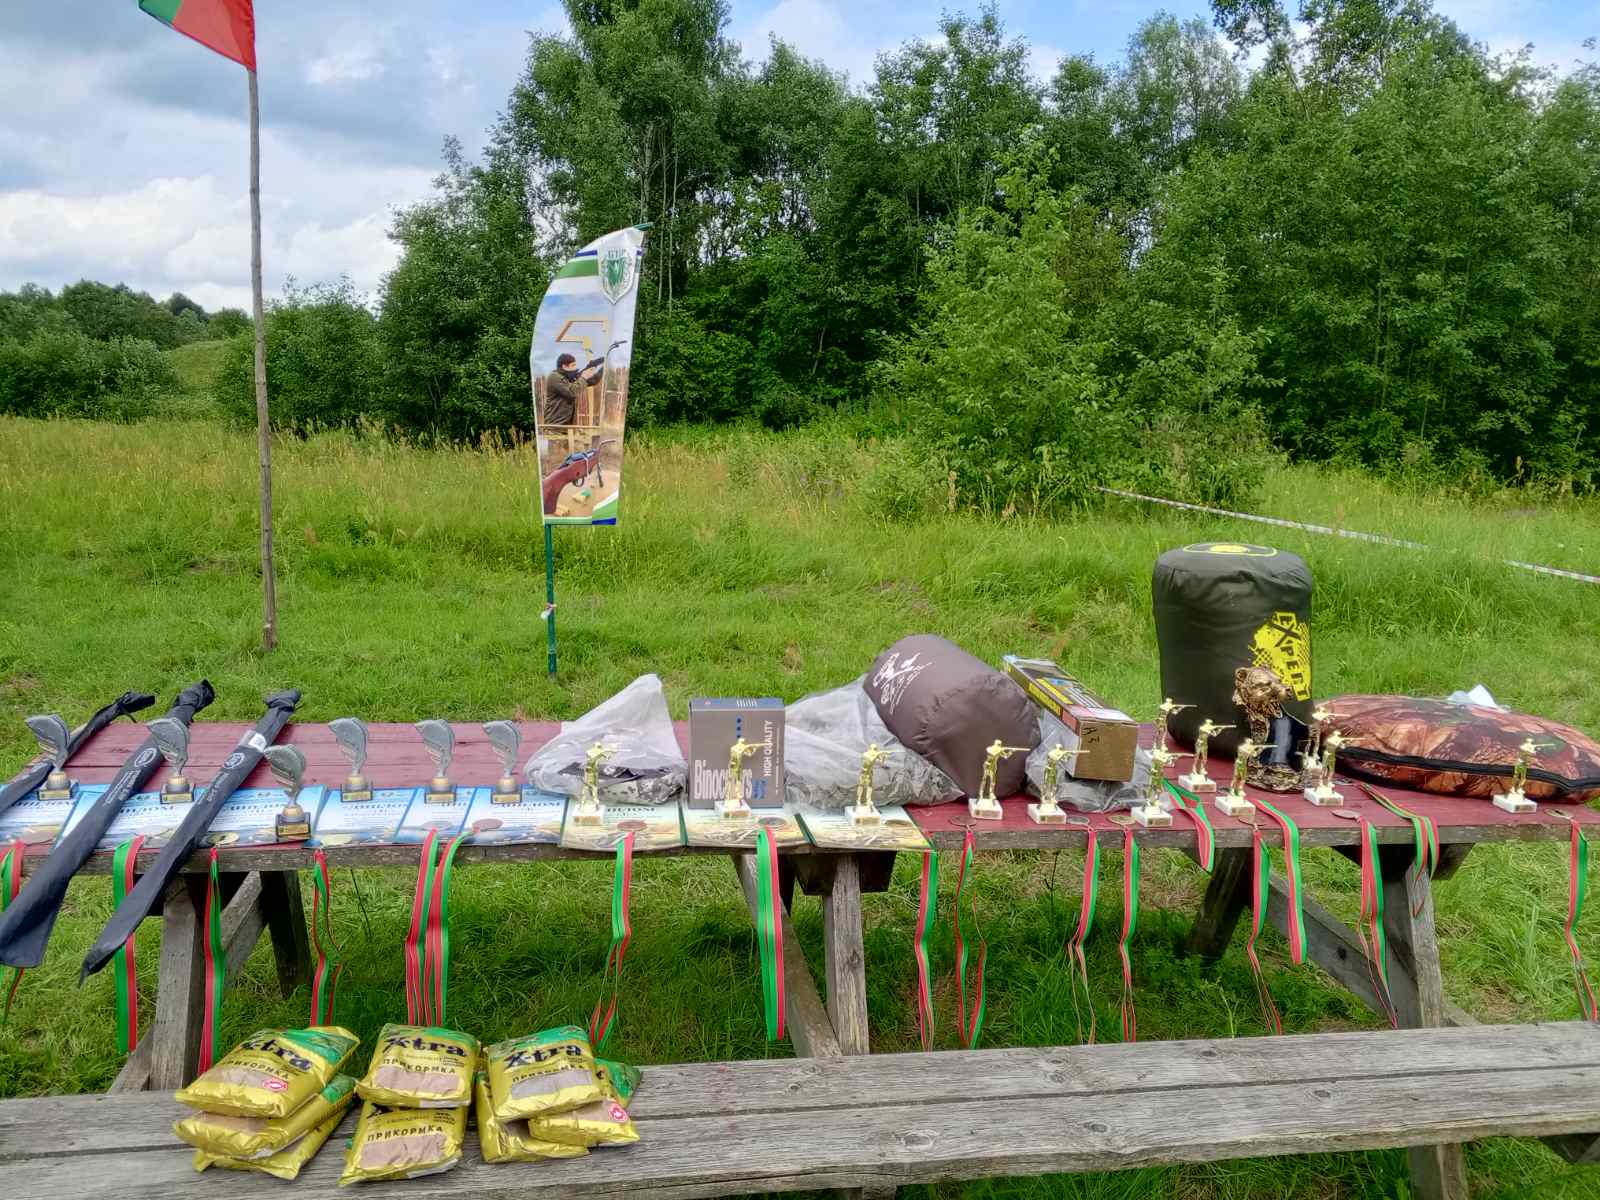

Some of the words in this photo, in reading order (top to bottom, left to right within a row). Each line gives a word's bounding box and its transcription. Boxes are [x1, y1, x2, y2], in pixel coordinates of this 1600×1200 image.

[763, 757, 772, 777] HIGH
[694, 760, 752, 799] Binocrs
[367, 1124, 444, 1142] ПРИКОРМКА
